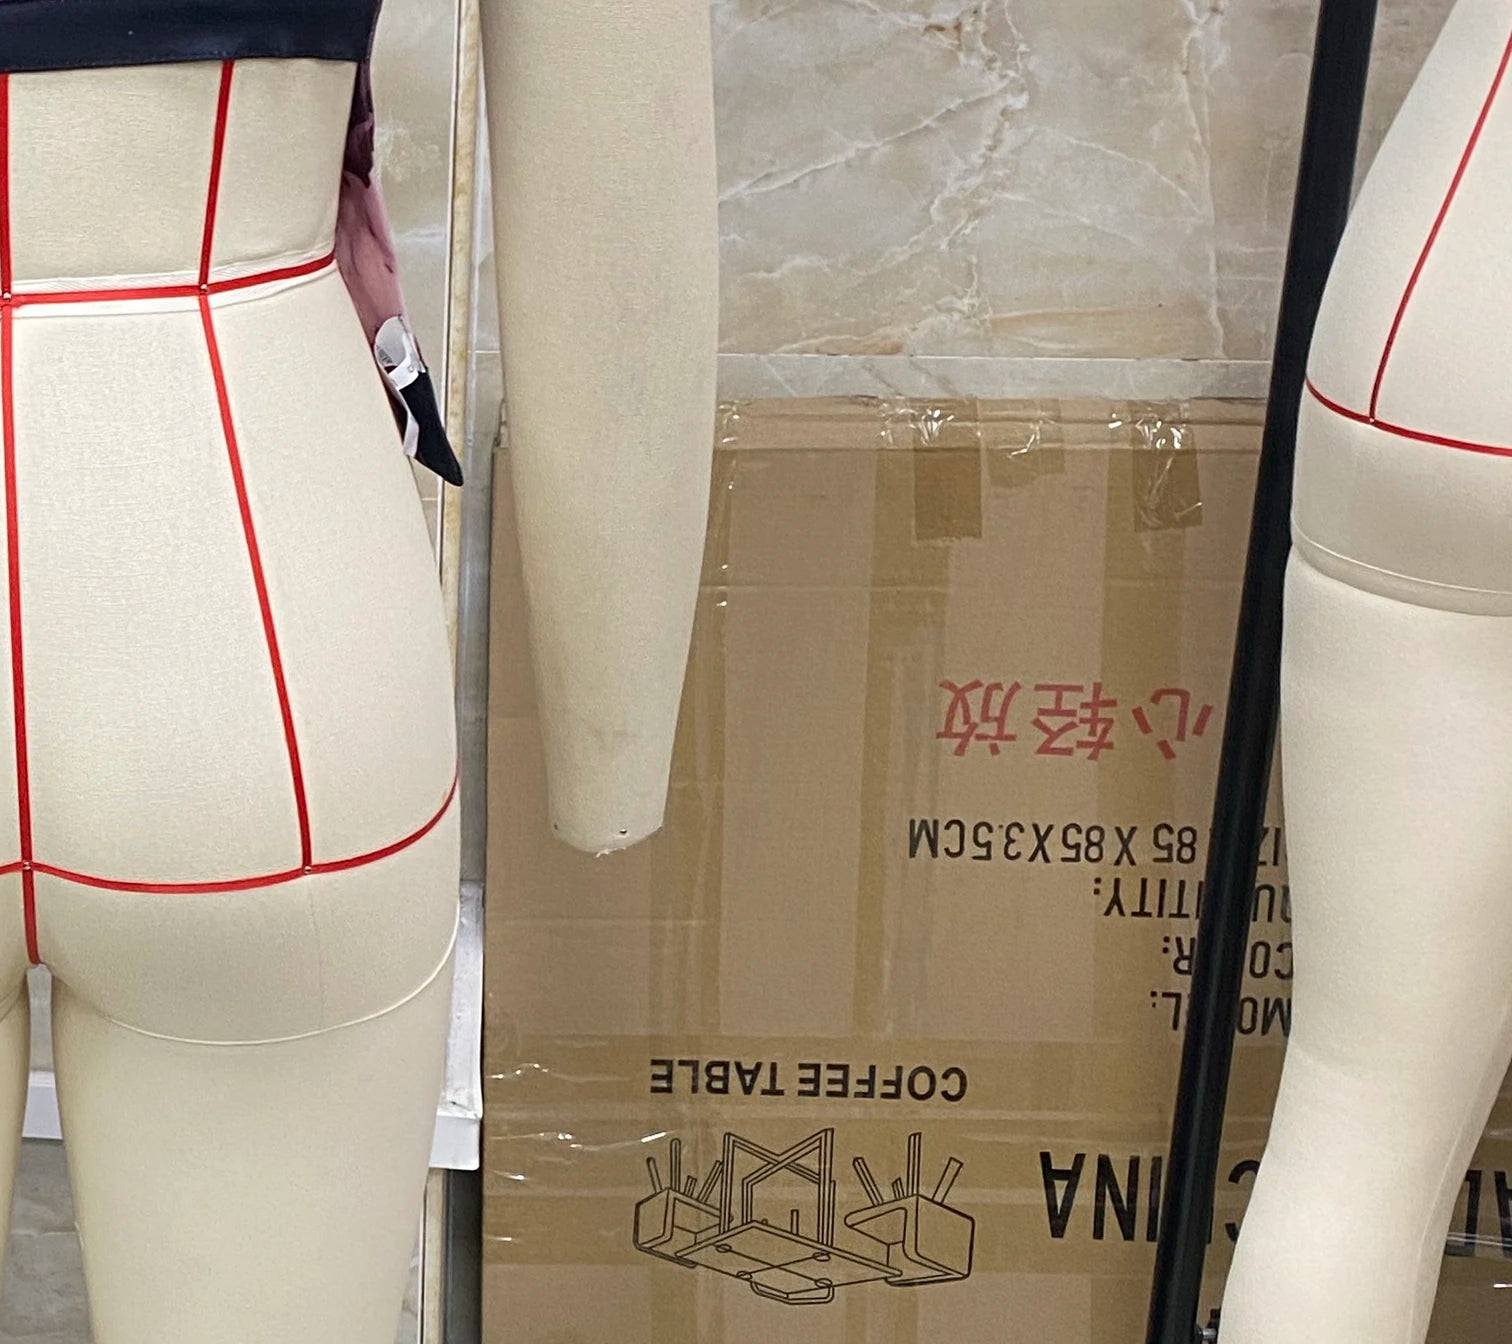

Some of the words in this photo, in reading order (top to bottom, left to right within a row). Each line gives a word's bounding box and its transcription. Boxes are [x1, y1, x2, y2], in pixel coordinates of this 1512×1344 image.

[1163, 936, 1293, 979] COR:
[1151, 991, 1291, 1036] MOL:
[650, 1058, 785, 1096] TABLE
[797, 1062, 968, 1102] COFFEE
[1039, 1151, 1261, 1243] CINA
